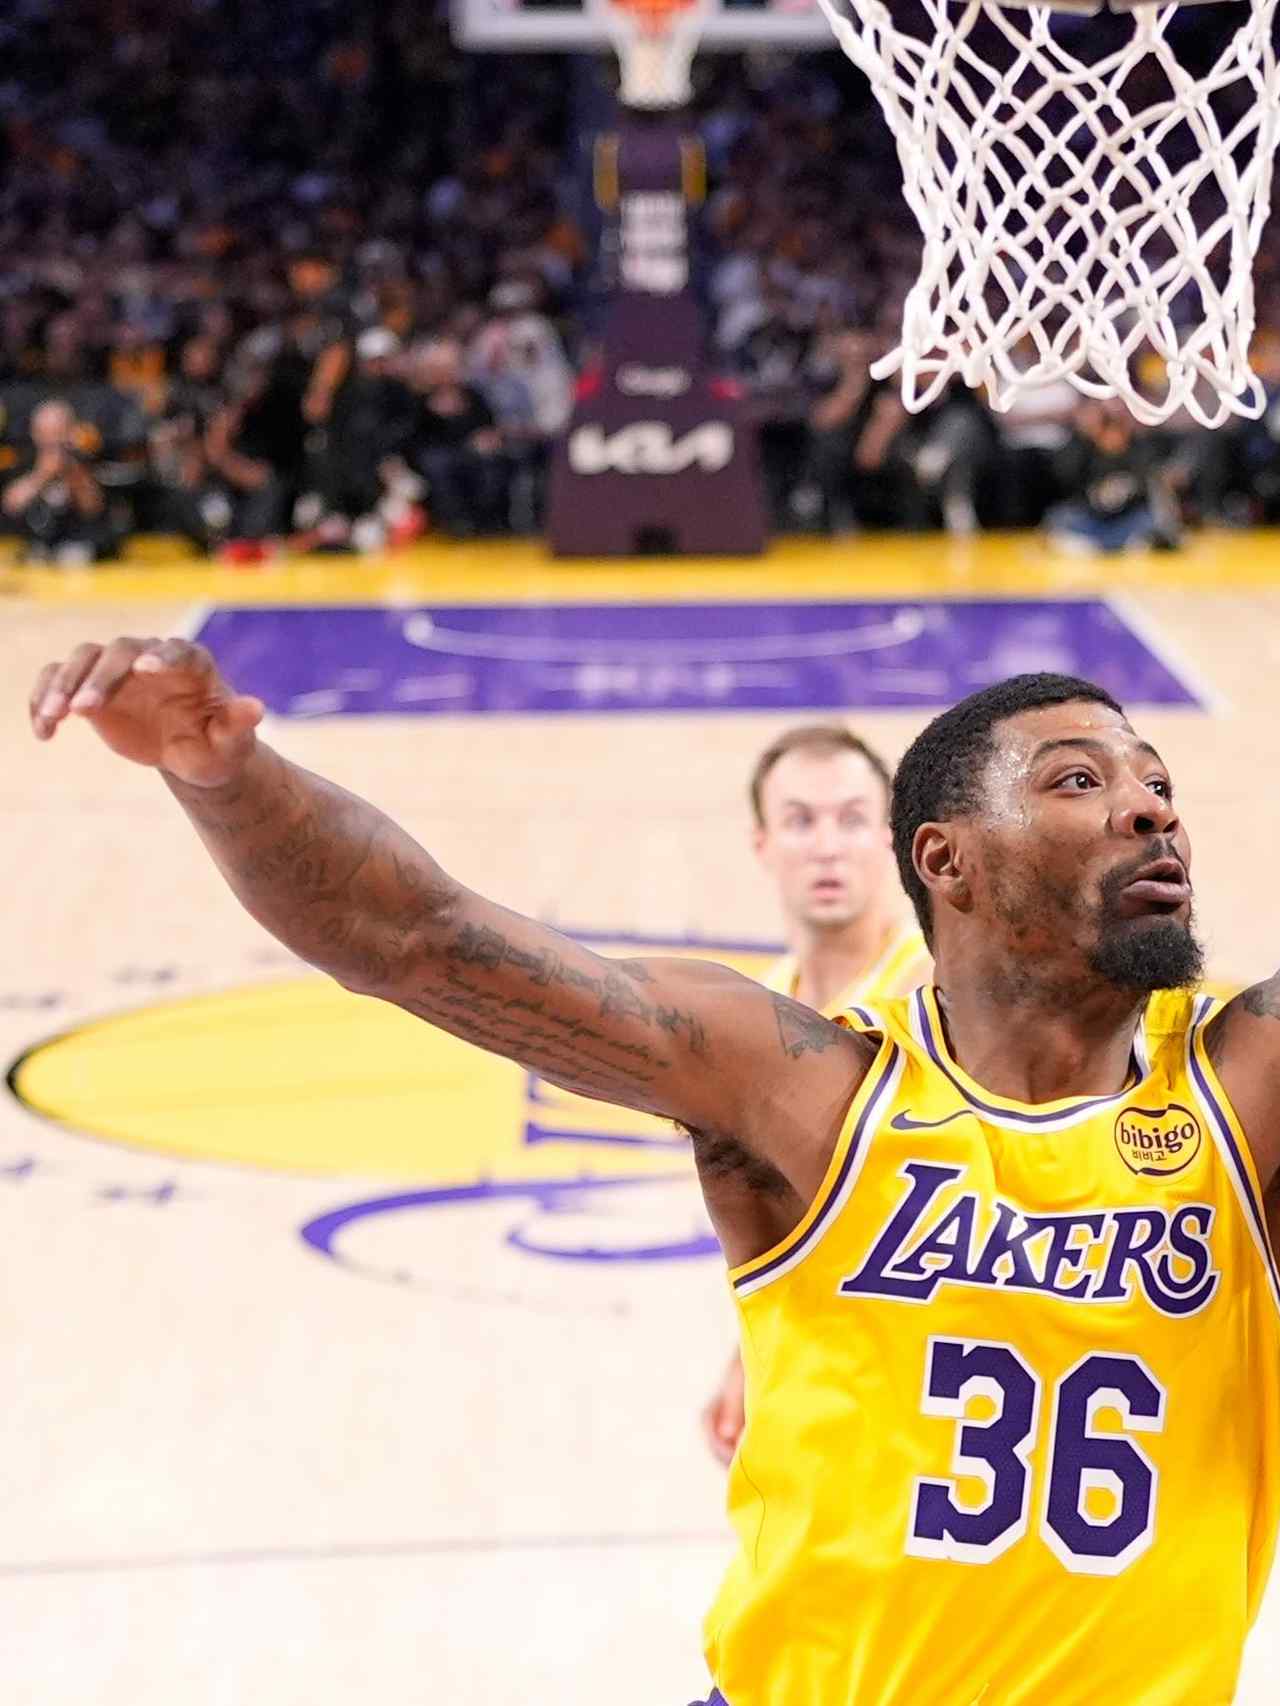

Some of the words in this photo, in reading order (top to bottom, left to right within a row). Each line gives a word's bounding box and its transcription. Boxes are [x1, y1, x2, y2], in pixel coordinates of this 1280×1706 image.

[1120, 1121, 1195, 1154] bibigo
[1131, 1150, 1168, 1162] 비비고
[840, 1159, 1220, 1316] LAKERS
[904, 1334, 1169, 1577] 36
